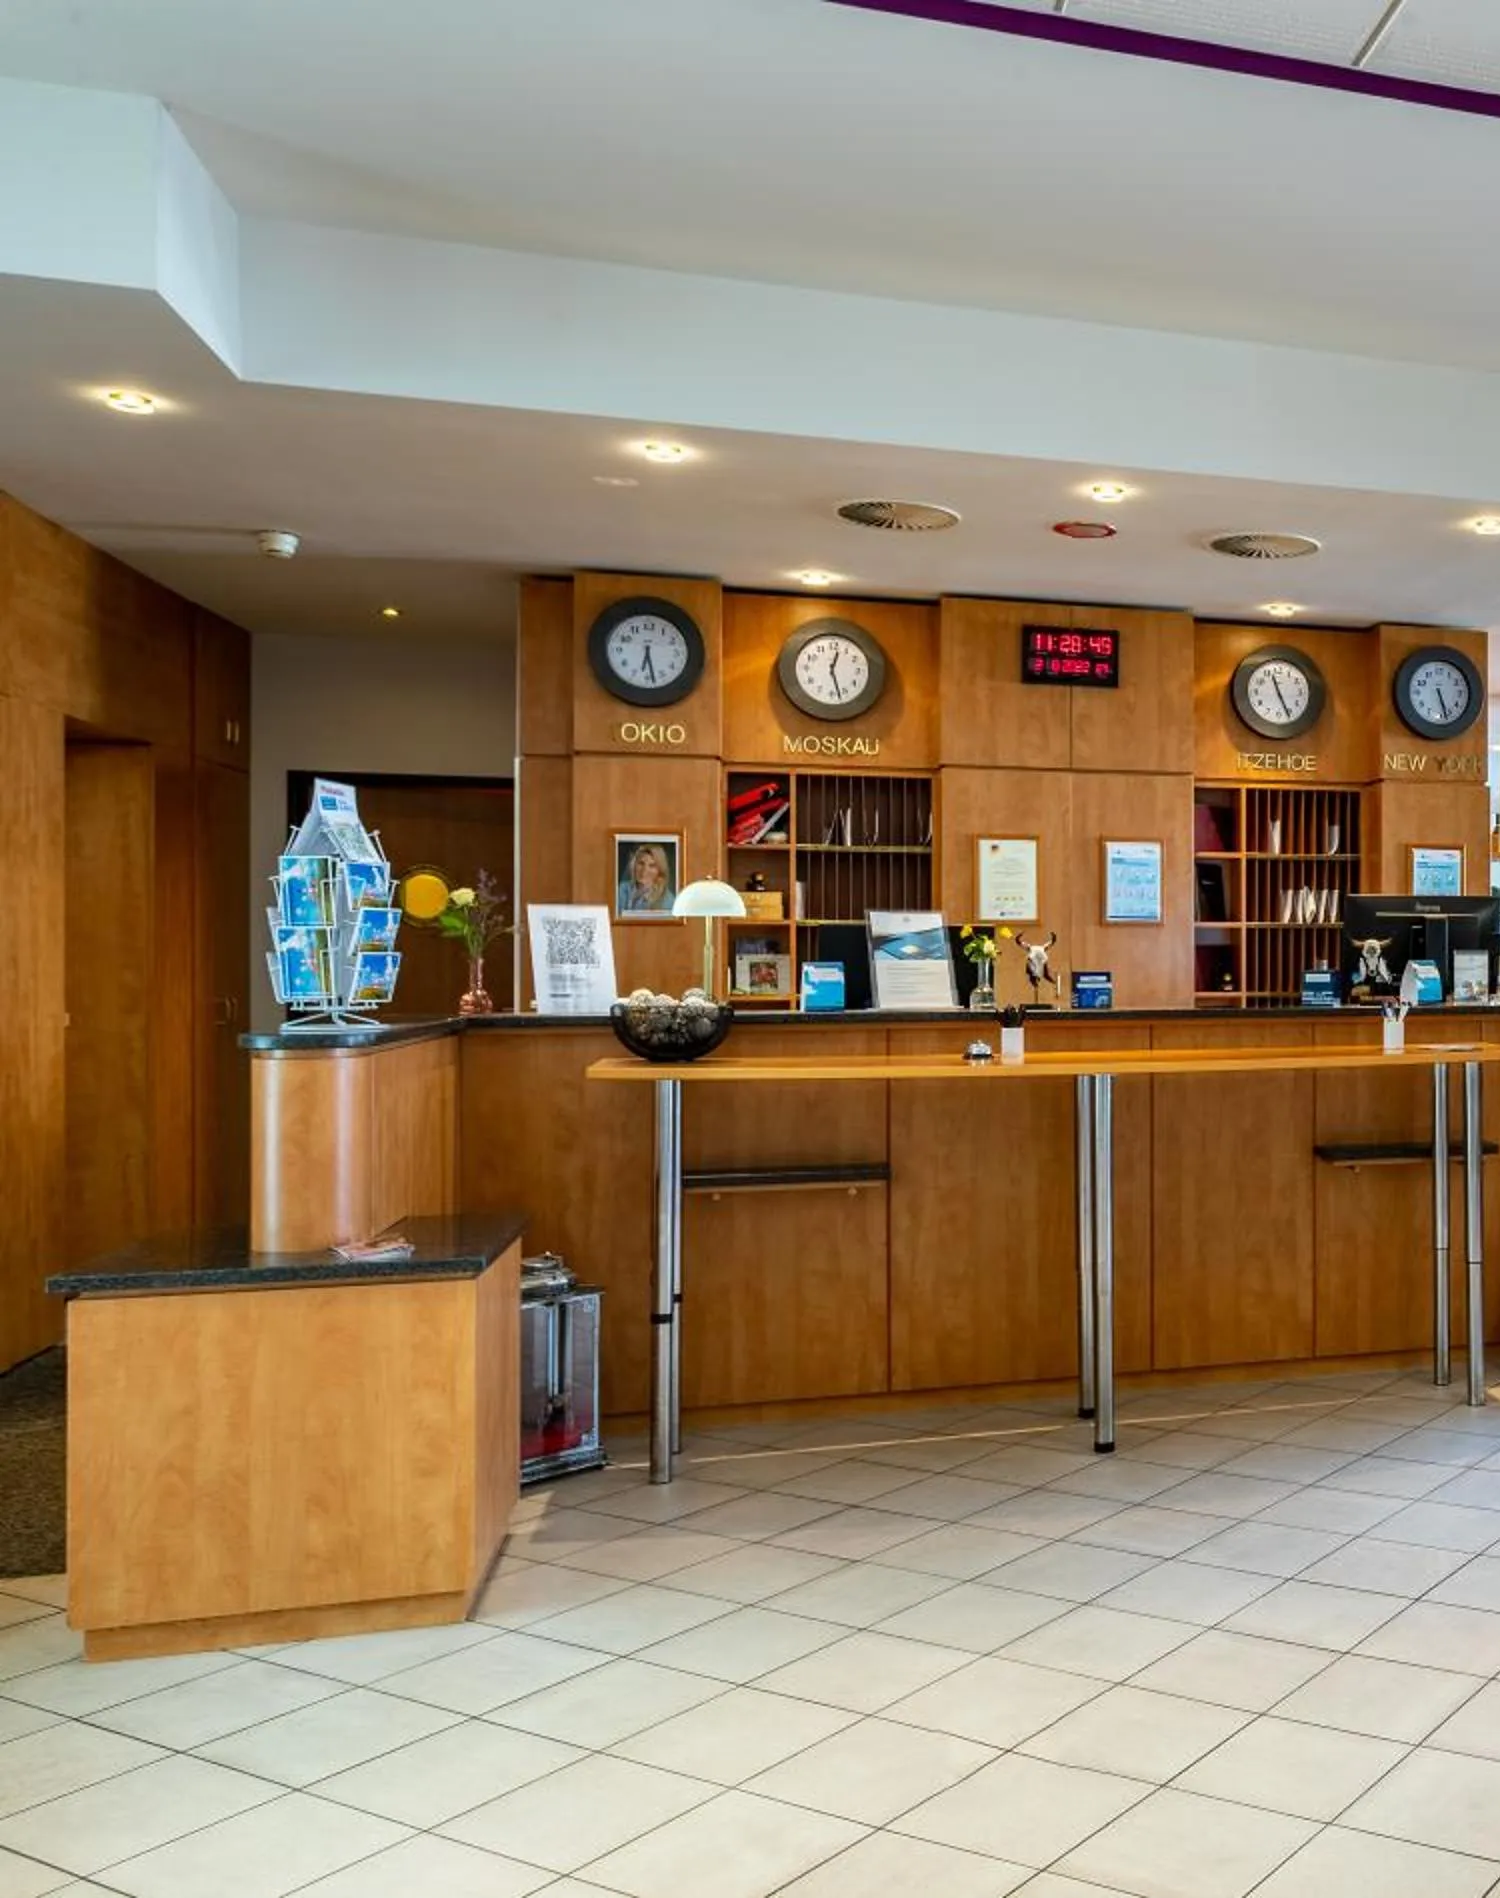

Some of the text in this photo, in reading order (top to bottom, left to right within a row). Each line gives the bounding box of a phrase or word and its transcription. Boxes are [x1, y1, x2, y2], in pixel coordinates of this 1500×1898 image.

[783, 735, 880, 755] MOSKAU
[1237, 752, 1317, 771] ITZEHOE
[1383, 753, 1427, 771] NEW
